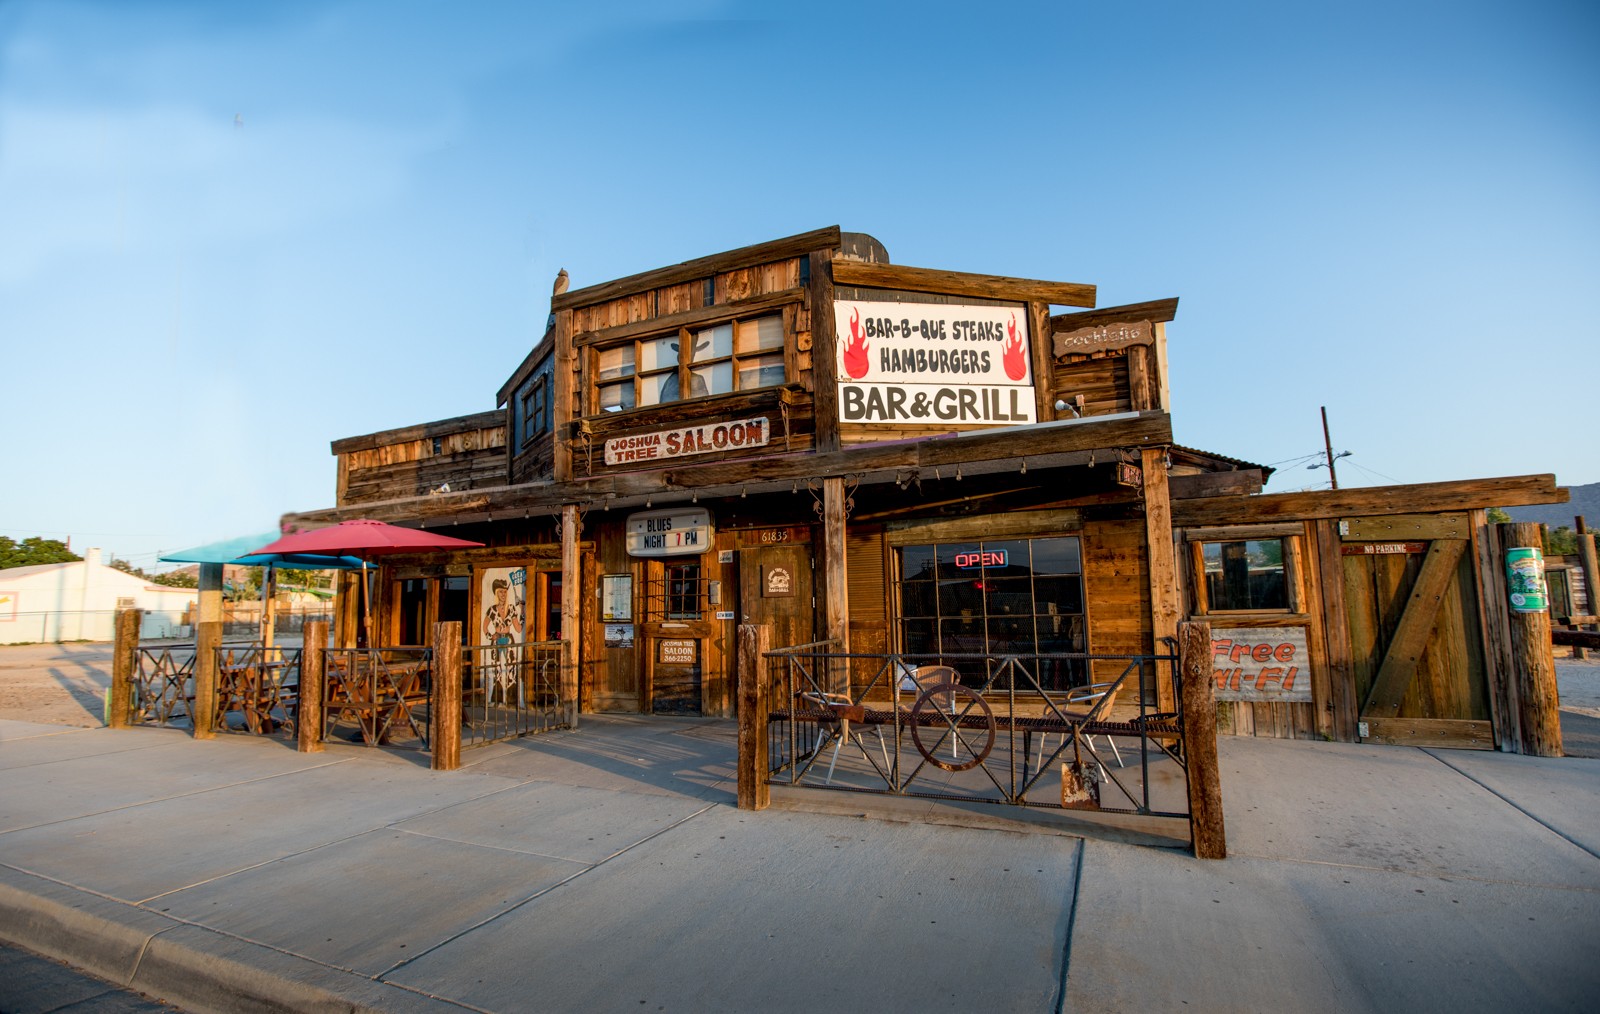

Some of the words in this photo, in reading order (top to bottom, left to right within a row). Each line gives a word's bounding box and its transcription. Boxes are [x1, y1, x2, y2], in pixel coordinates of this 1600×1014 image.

[865, 317, 946, 340] BAR-B-QUE
[952, 320, 1004, 342] STEAKS
[880, 347, 991, 374] HAMBURGERS
[843, 386, 1029, 421] BAR&GRILL
[611, 434, 661, 451] JOSHUA
[665, 422, 762, 453] SALOON
[615, 446, 658, 462] TREE
[647, 517, 672, 532] BLUES
[644, 534, 667, 549] NIGHT
[676, 533, 681, 546] 7
[685, 531, 698, 545] PM
[761, 531, 788, 542] 61835
[1364, 545, 1374, 554] NO
[1375, 544, 1407, 554] PARKING
[955, 553, 1004, 566] OPEN
[664, 647, 692, 655] SALOON
[1211, 639, 1296, 664] Free
